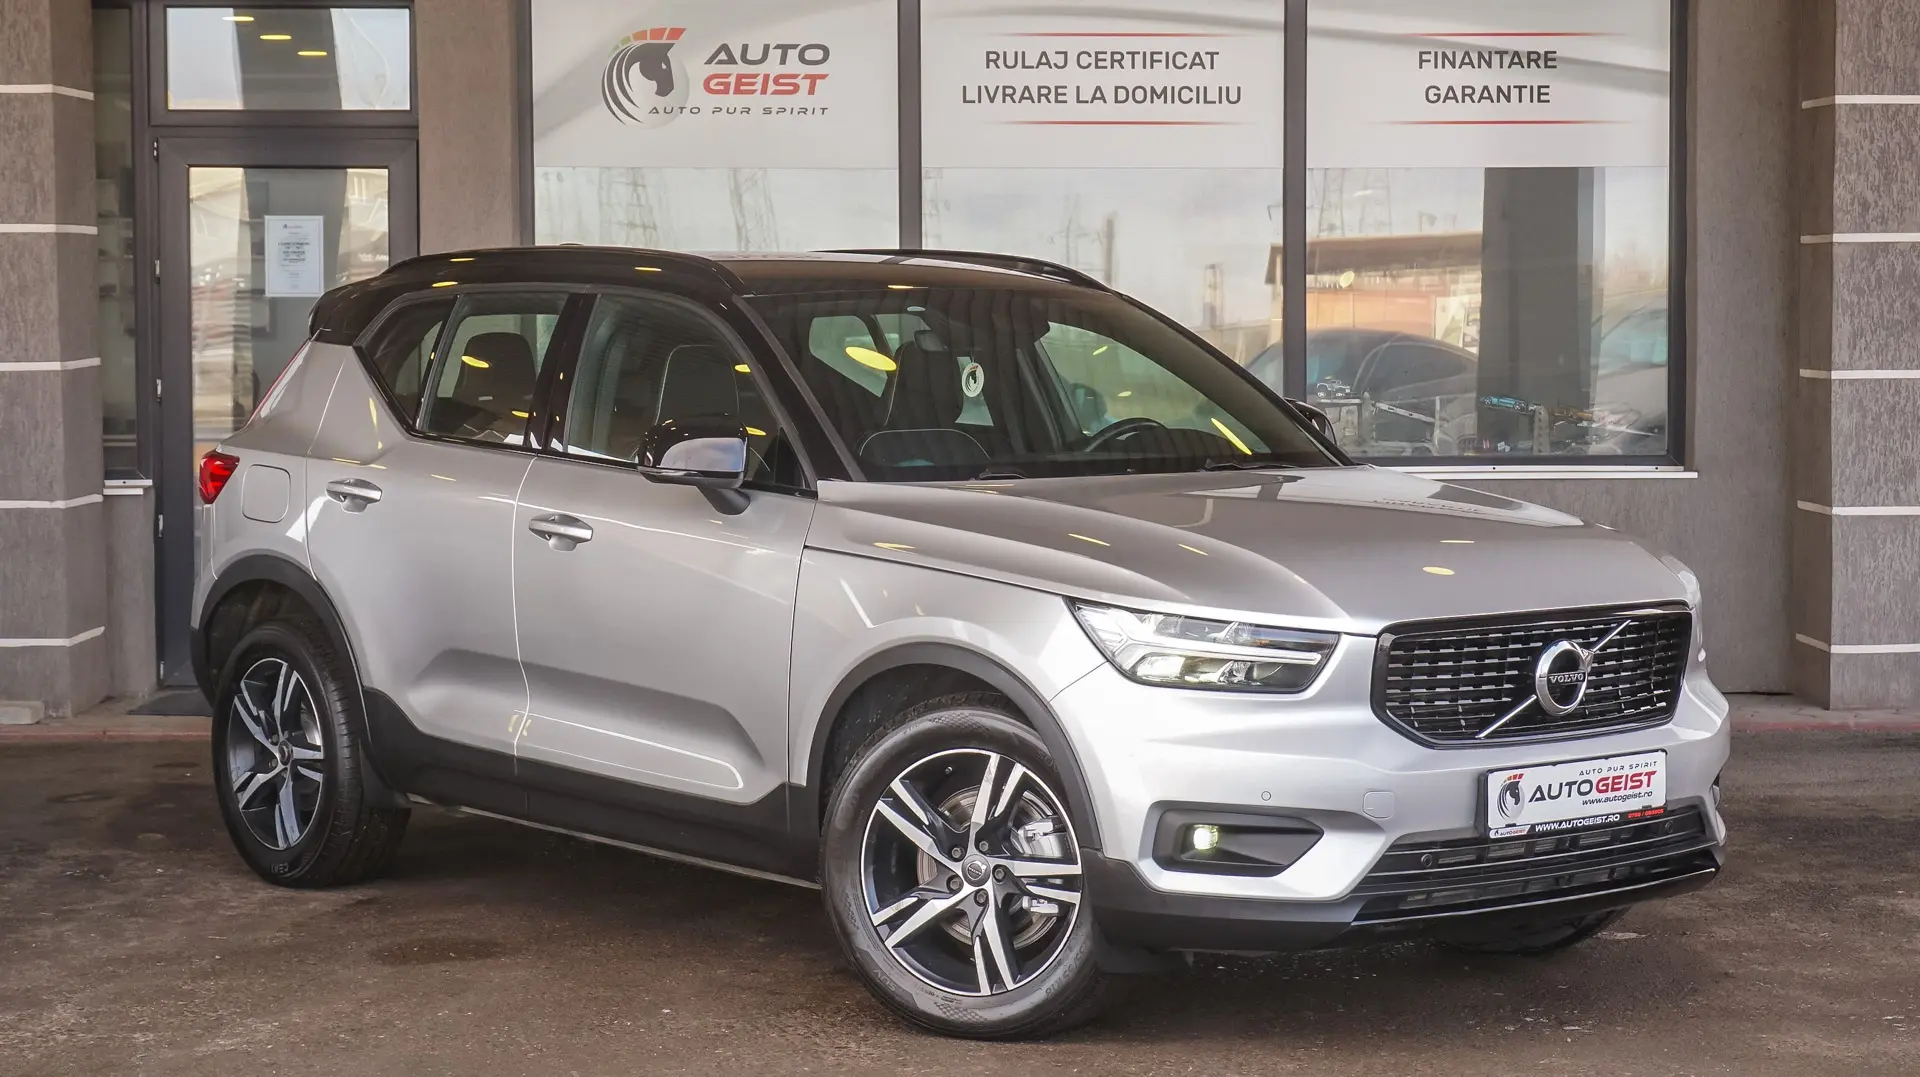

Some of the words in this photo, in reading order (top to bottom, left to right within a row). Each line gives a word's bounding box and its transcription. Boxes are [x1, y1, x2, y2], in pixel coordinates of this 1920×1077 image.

[703, 43, 831, 66] AUTO
[985, 50, 1069, 70] RULAJ
[1076, 50, 1220, 70] CERTIFICAT
[1418, 50, 1558, 69] FINANTARE
[702, 73, 830, 96] GEIST
[962, 85, 1068, 104] LIVRARE
[1075, 85, 1107, 104] LA
[1114, 85, 1242, 105] DOMICILIU
[1424, 85, 1551, 104] GARANTIE
[648, 106, 701, 116] AUTO
[711, 106, 752, 116] PUR
[762, 106, 829, 116] SPIRIT
[1549, 673, 1584, 683] VOLVO
[1579, 768, 1602, 776] AUTO
[1606, 765, 1625, 773] PUR
[1629, 761, 1658, 769] SPIRIT
[1581, 790, 1653, 806] www.autogeist.ro
[1535, 814, 1620, 832] WWW.AUTOGEIST.RO
